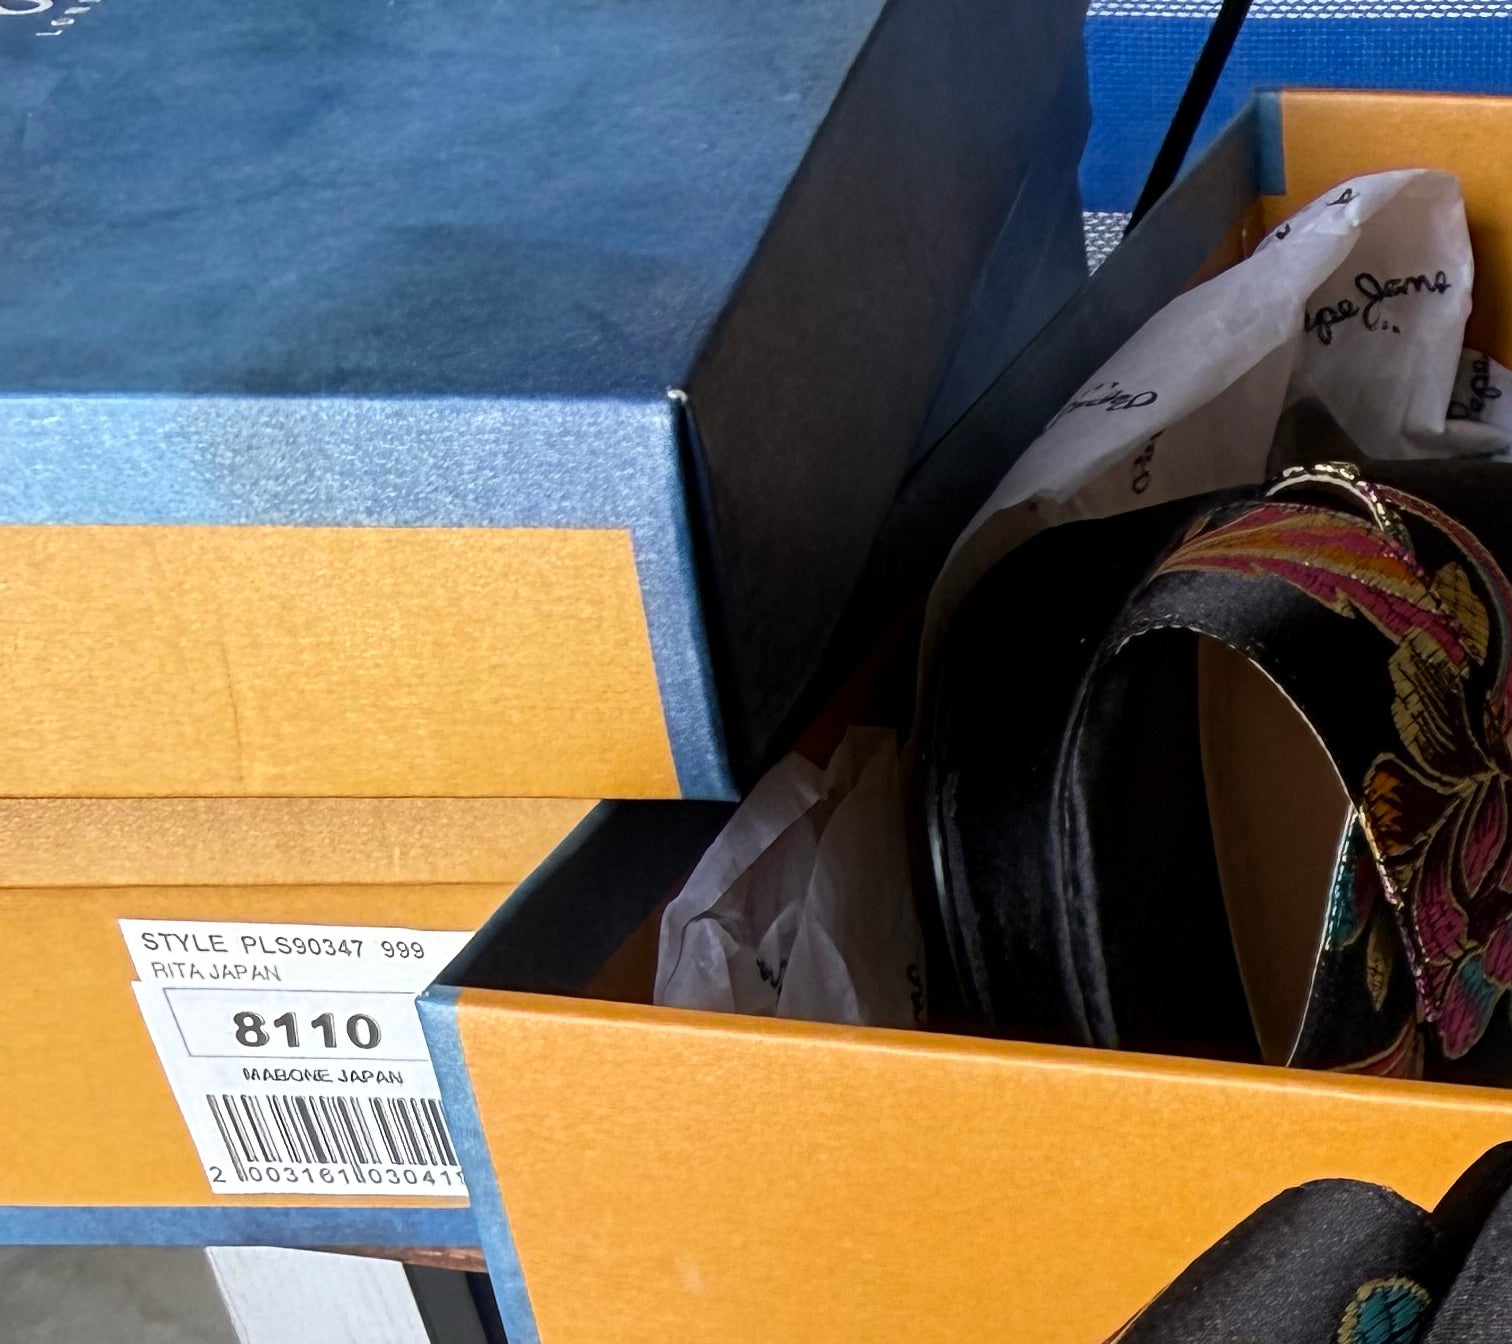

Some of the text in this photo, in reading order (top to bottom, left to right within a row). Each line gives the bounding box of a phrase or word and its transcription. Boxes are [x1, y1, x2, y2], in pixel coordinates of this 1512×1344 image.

[141, 932, 425, 959] STYLE PLS90347 999
[151, 962, 281, 982] RITA JAPAN
[233, 1010, 382, 1050] 8110
[338, 1069, 404, 1085] JAPAN
[209, 1166, 227, 1184] 2
